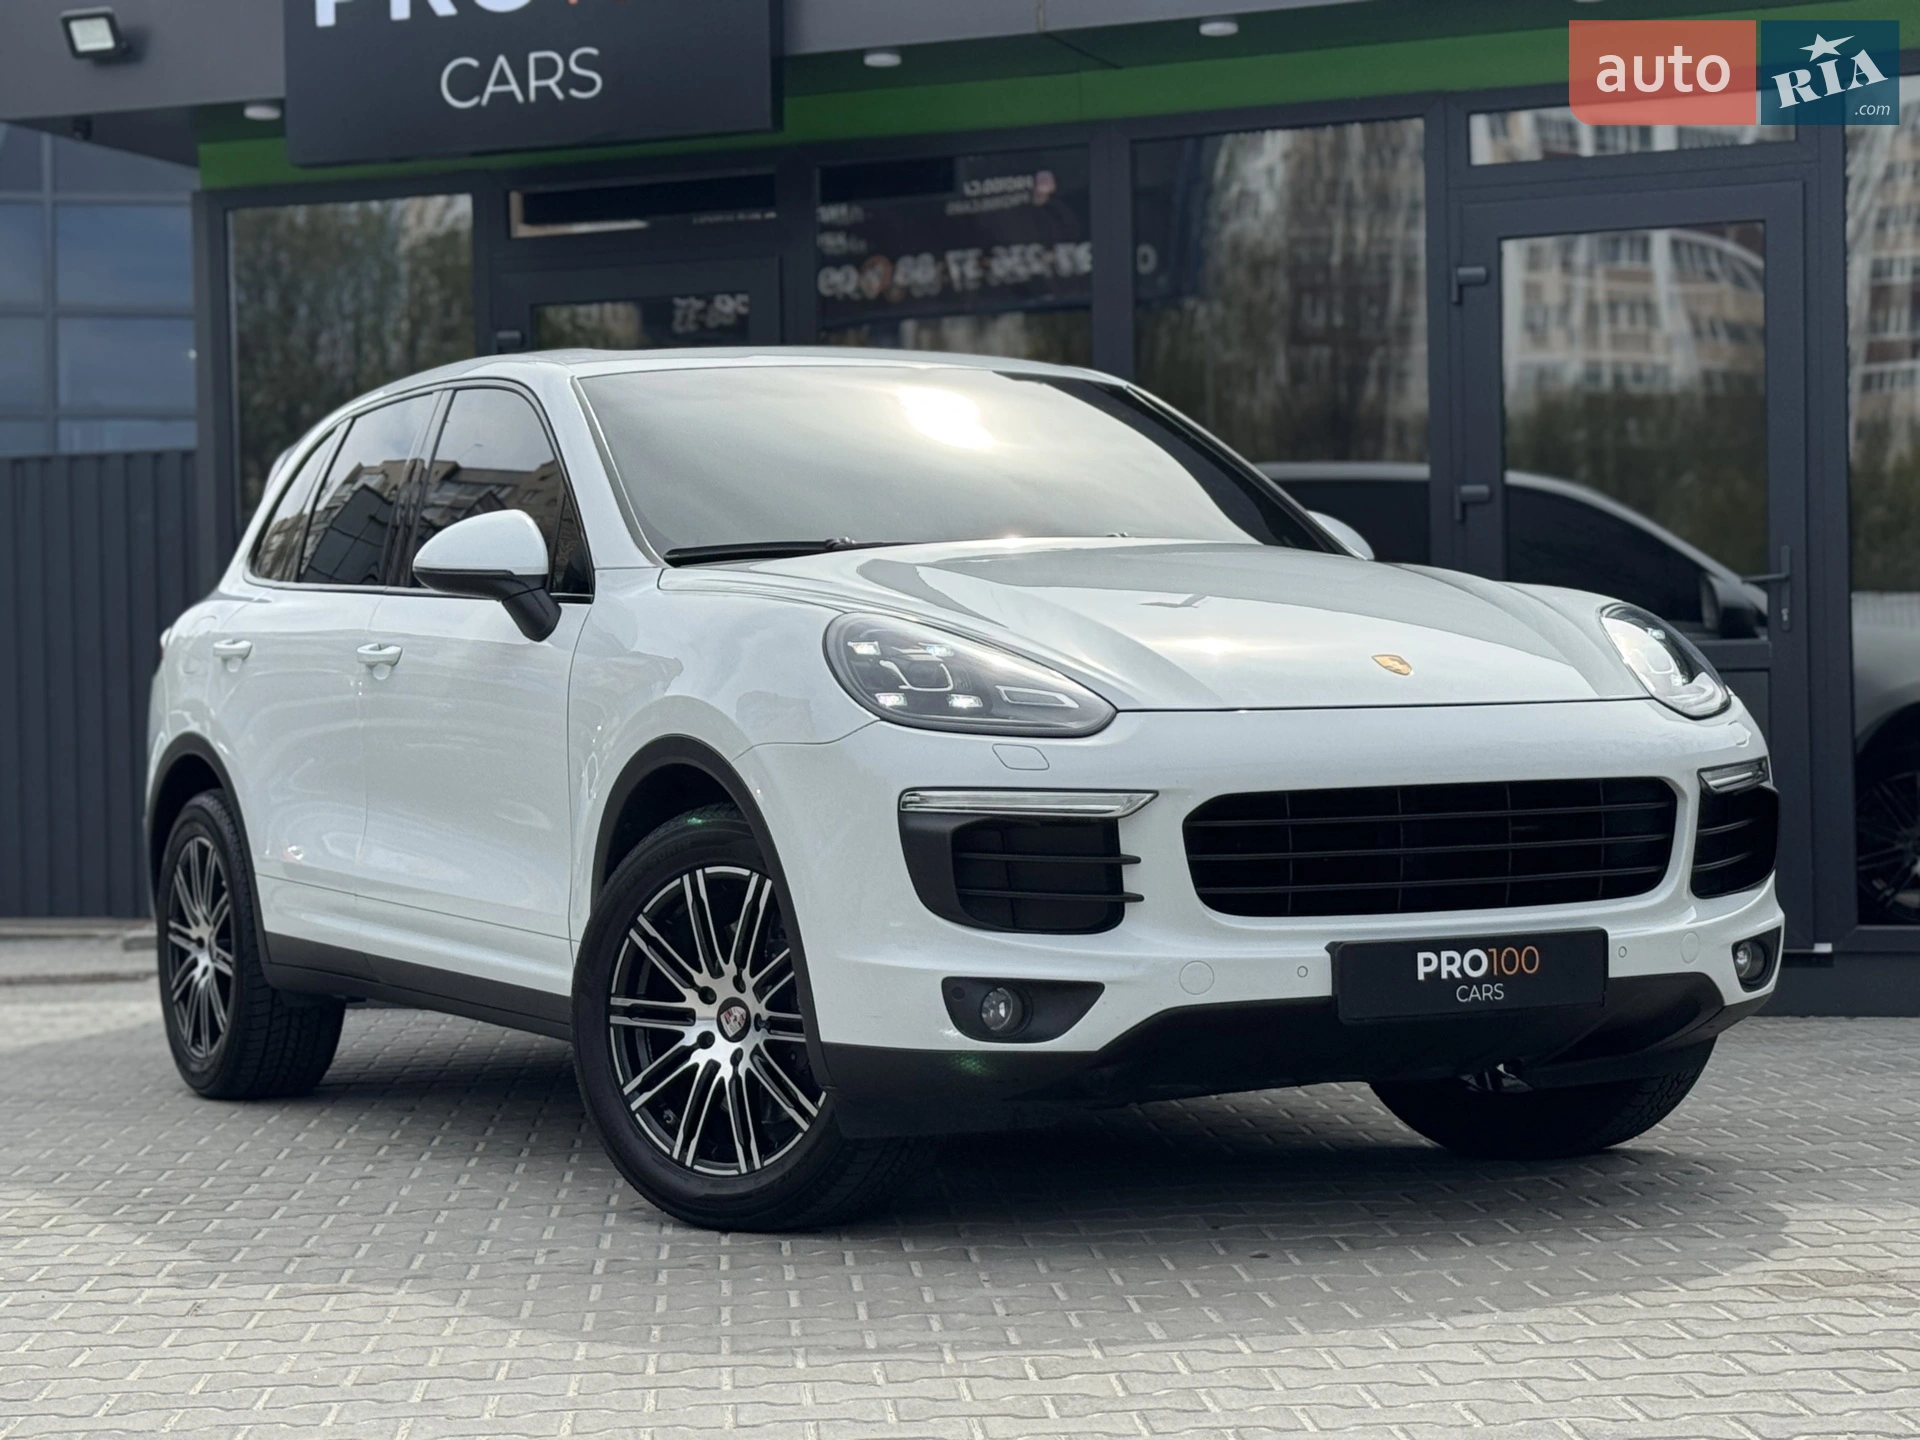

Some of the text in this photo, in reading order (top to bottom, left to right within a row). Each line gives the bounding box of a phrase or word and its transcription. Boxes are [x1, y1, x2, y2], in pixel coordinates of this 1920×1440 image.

[440, 47, 602, 108] CARS
[1417, 945, 1540, 980] PRO100
[1456, 983, 1504, 1002] CARS
